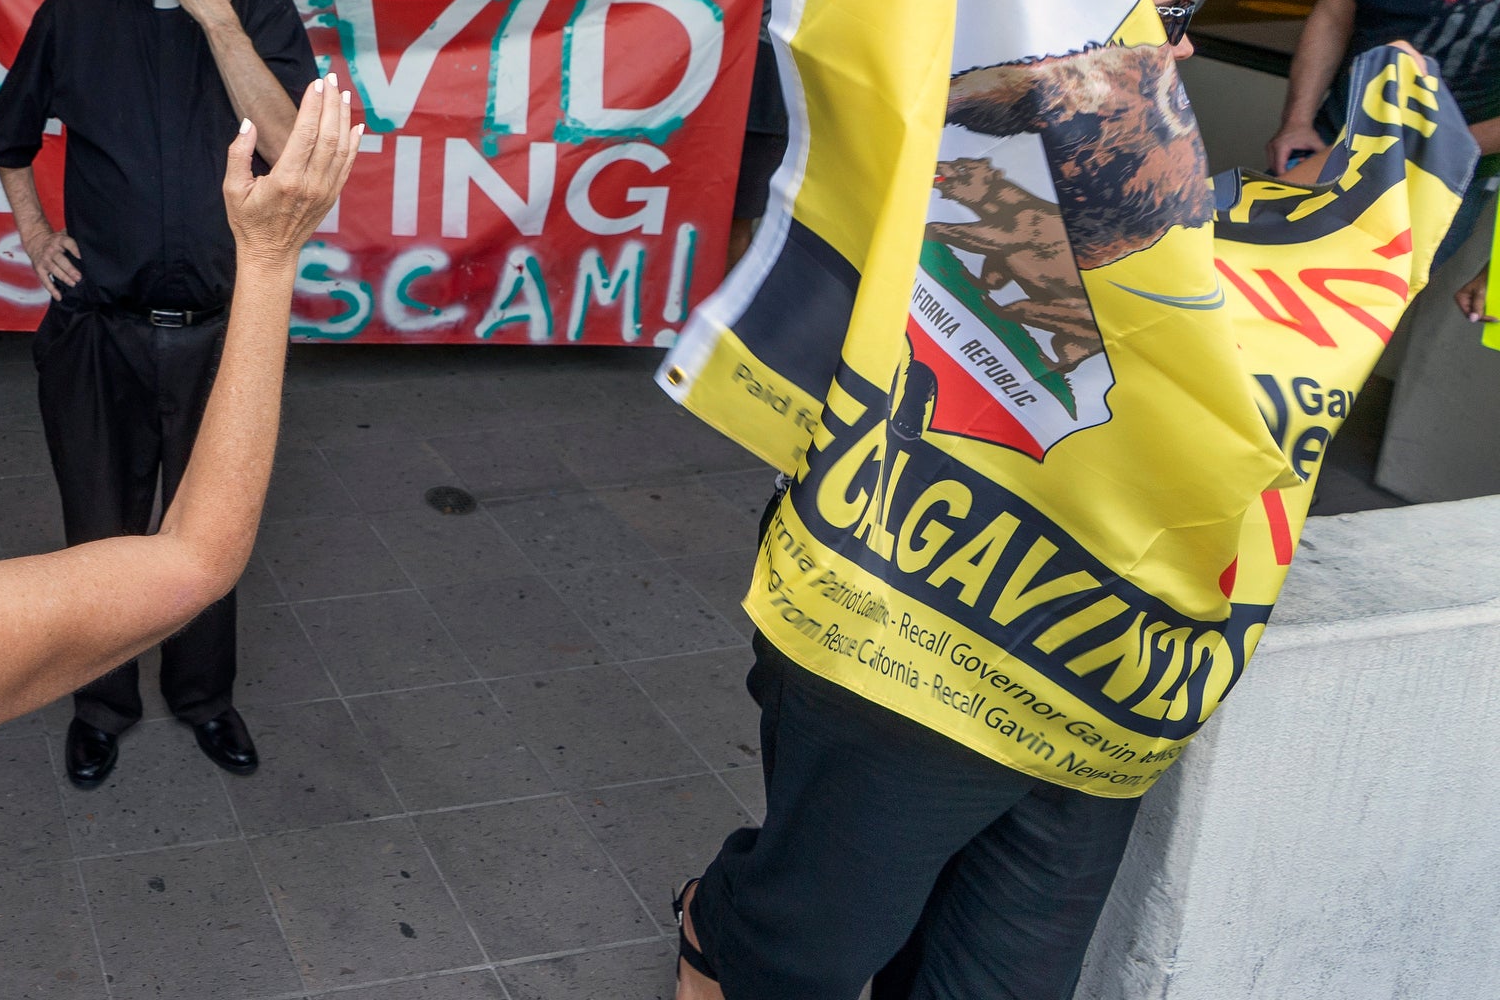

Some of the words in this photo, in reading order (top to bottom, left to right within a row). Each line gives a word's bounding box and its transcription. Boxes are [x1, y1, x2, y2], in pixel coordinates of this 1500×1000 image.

[731, 362, 793, 417] Paid
[911, 278, 961, 339] IFORNIA
[959, 339, 1037, 407] REPUBLIC
[898, 612, 952, 657] Recall
[950, 643, 1067, 723] Governor
[1065, 720, 1137, 763] Gavin
[931, 673, 987, 719] Recall
[984, 706, 1056, 761] Gavin
